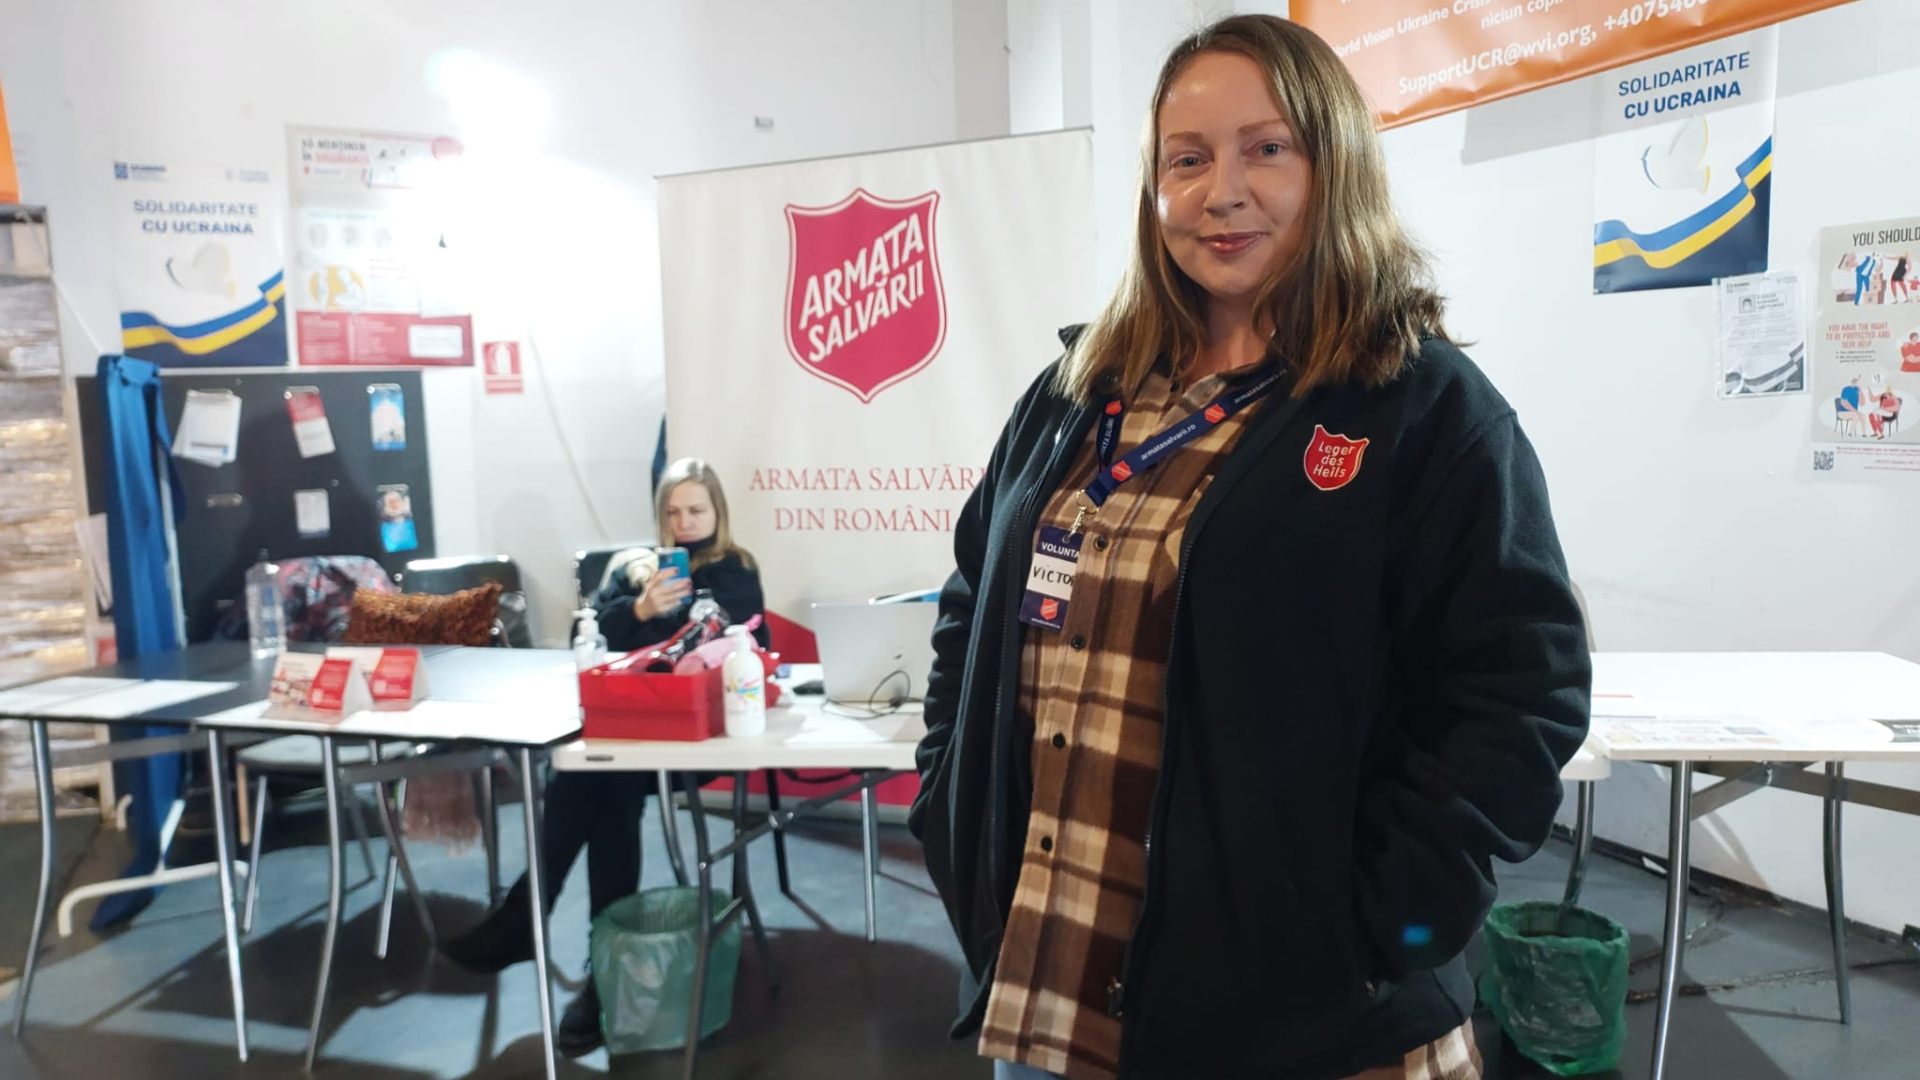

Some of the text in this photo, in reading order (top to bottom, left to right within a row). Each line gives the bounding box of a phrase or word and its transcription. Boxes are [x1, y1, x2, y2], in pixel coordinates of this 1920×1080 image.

[1363, 27, 1395, 48] Vision
[1397, 7, 1449, 35] Ukraine
[1453, 0, 1490, 15] Cris
[1481, 4, 1523, 29] niciun
[1398, 22, 1597, 95] SupportUCR@wvi.org,
[1618, 51, 1751, 97] SOLIDARITATE
[1624, 81, 1742, 119] CU UCRAINA
[133, 200, 258, 217] SOLIDARITATE
[142, 219, 255, 235] CU UCRAINA
[1852, 231, 1875, 247] YOU
[799, 212, 925, 331] ARMATA
[808, 259, 925, 362] SALVĂRII
[1140, 423, 1197, 461] armatasalvarii.ro
[1318, 441, 1356, 457] Leger
[1312, 463, 1347, 478] Heils
[1321, 454, 1345, 466] des
[749, 468, 864, 491] ARMATA
[774, 507, 825, 531] DIN
